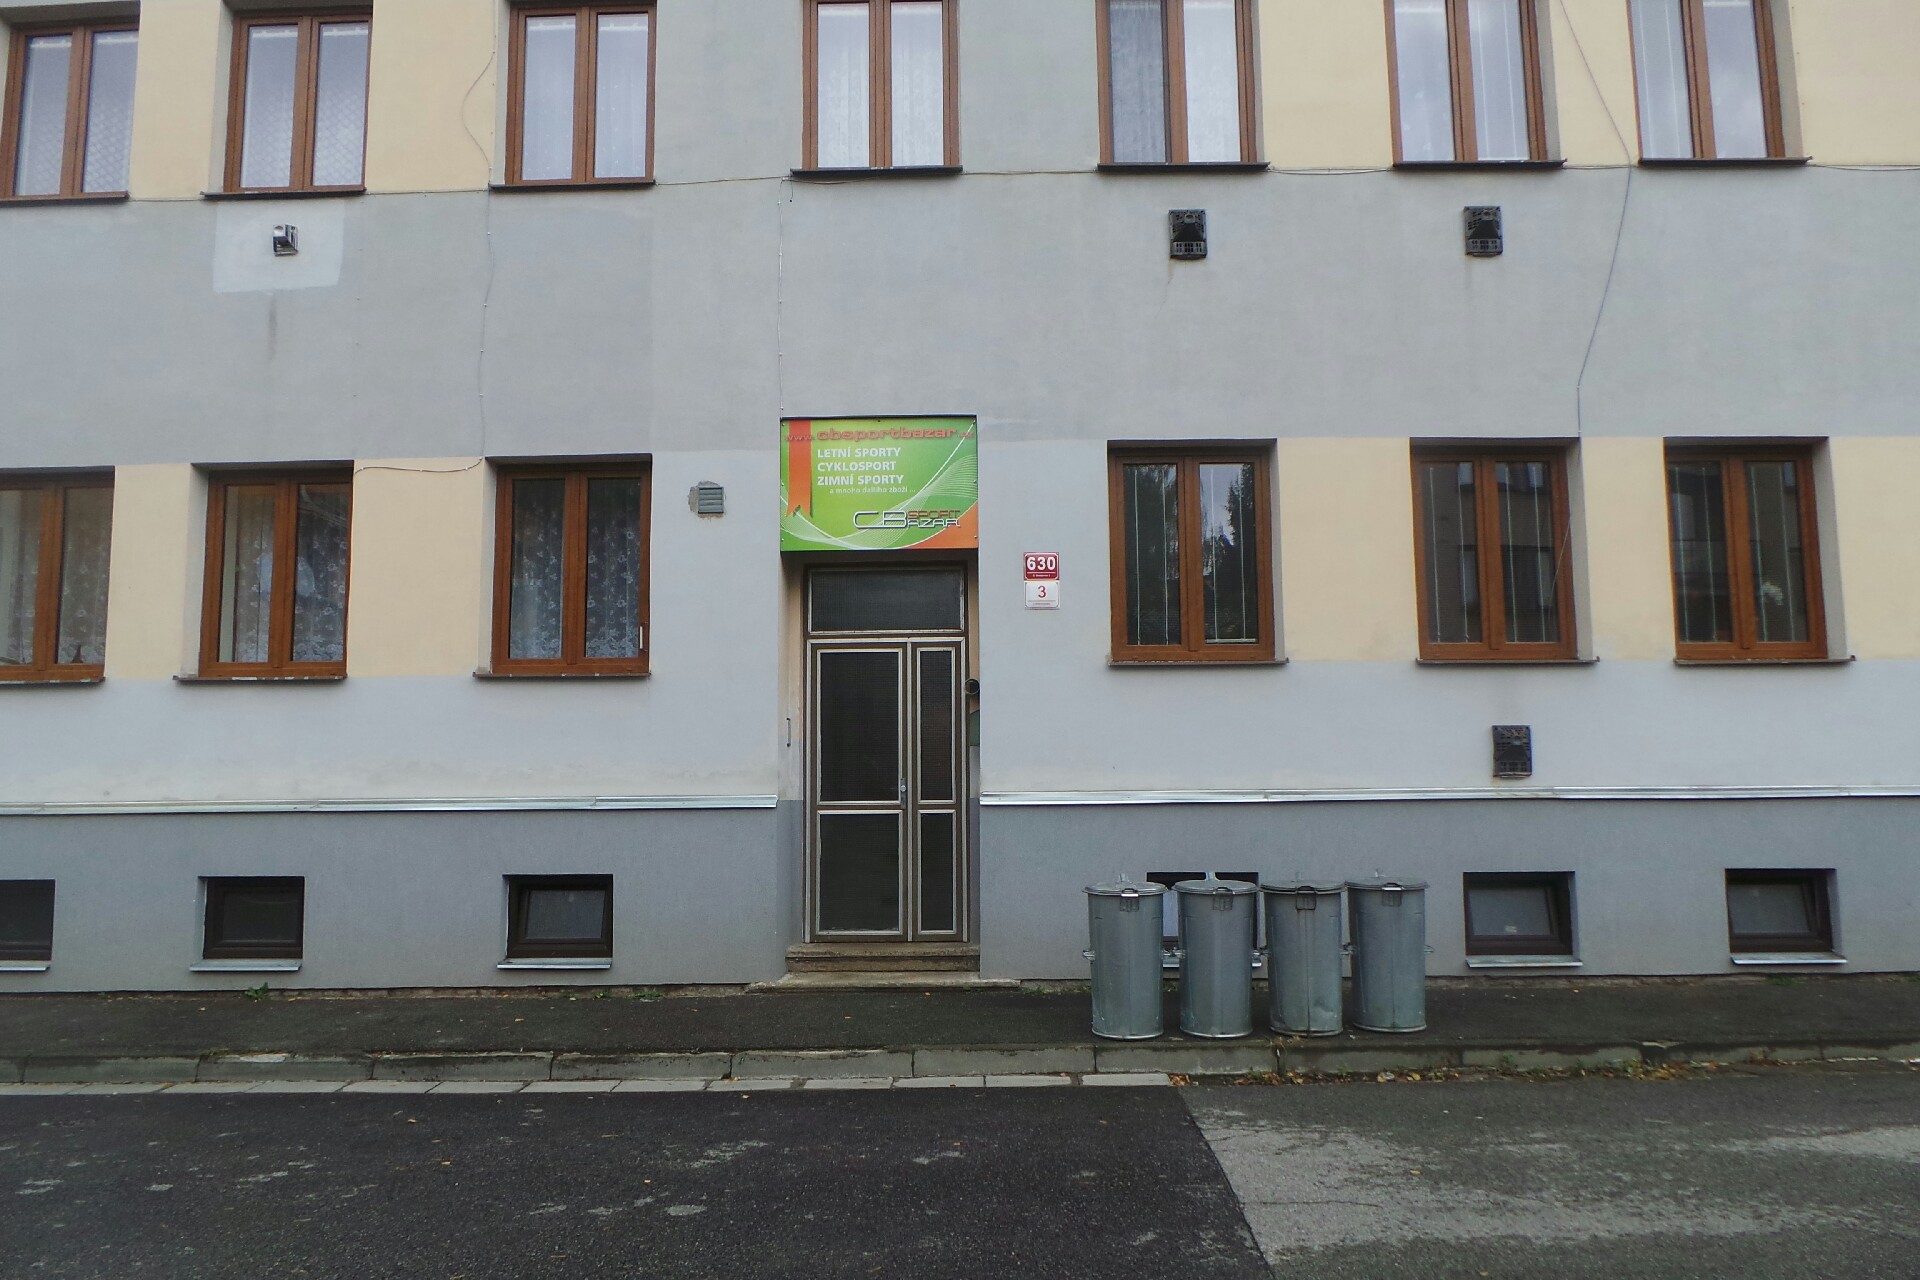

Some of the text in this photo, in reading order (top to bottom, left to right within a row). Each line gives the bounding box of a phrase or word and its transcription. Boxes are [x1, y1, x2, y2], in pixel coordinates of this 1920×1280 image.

[817, 447, 901, 458] LETNÍ SPORTY
[817, 461, 897, 472] CYKLOSPORT
[817, 474, 904, 486] ZIMNÍ SPORTY
[1026, 556, 1056, 571] 630
[1037, 585, 1047, 599] 3
